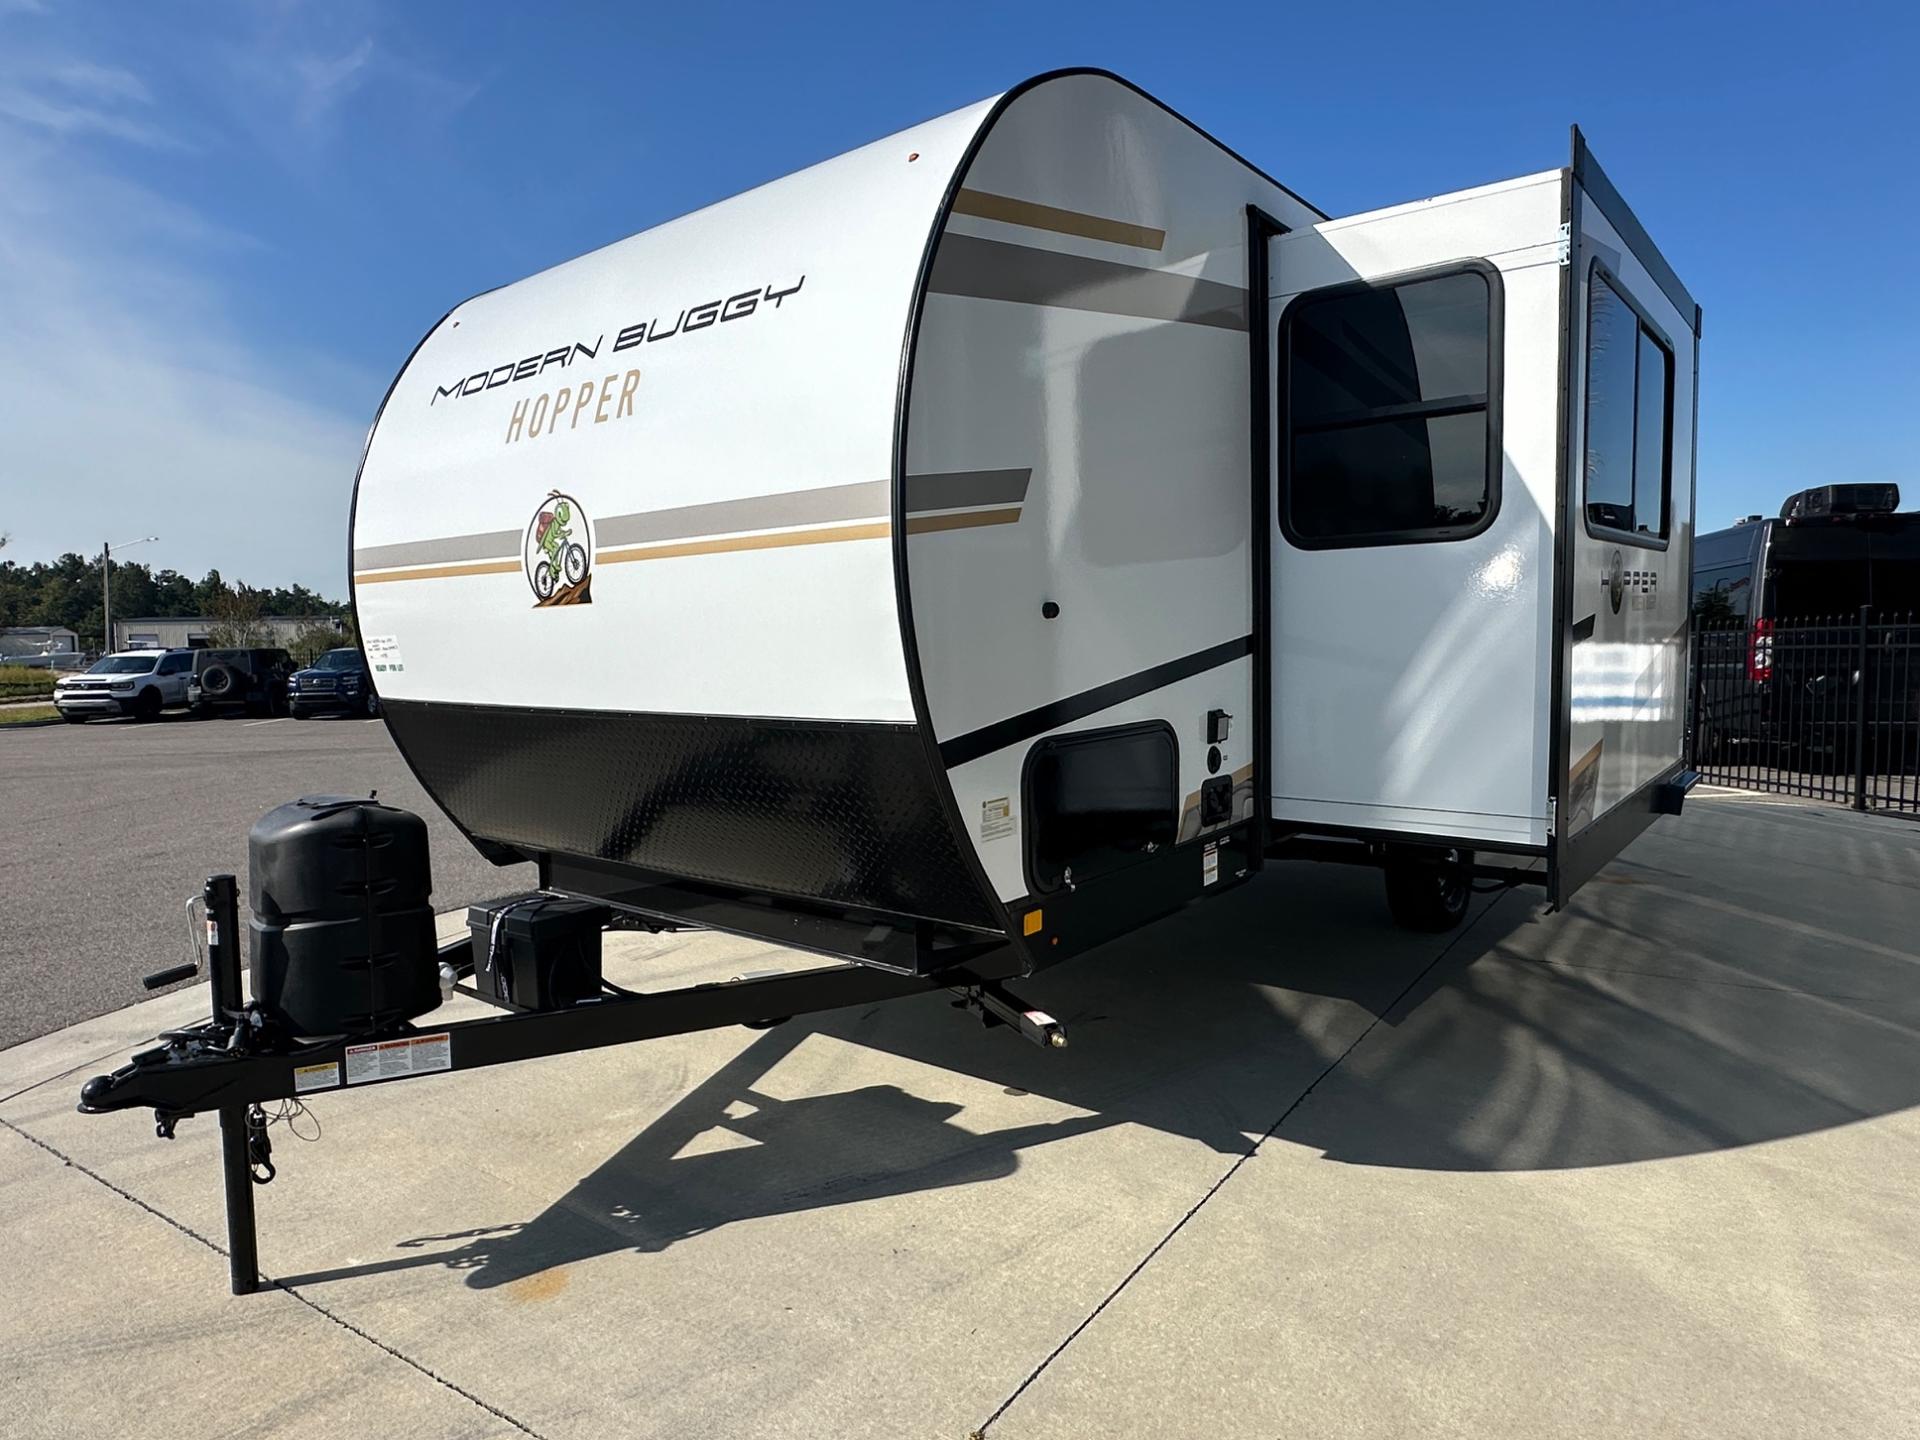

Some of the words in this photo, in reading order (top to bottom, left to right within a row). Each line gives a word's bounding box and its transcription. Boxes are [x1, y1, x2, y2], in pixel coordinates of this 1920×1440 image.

[430, 334, 604, 406] MODERN
[612, 275, 806, 352] BUGGY
[505, 368, 643, 444] HOPPER
